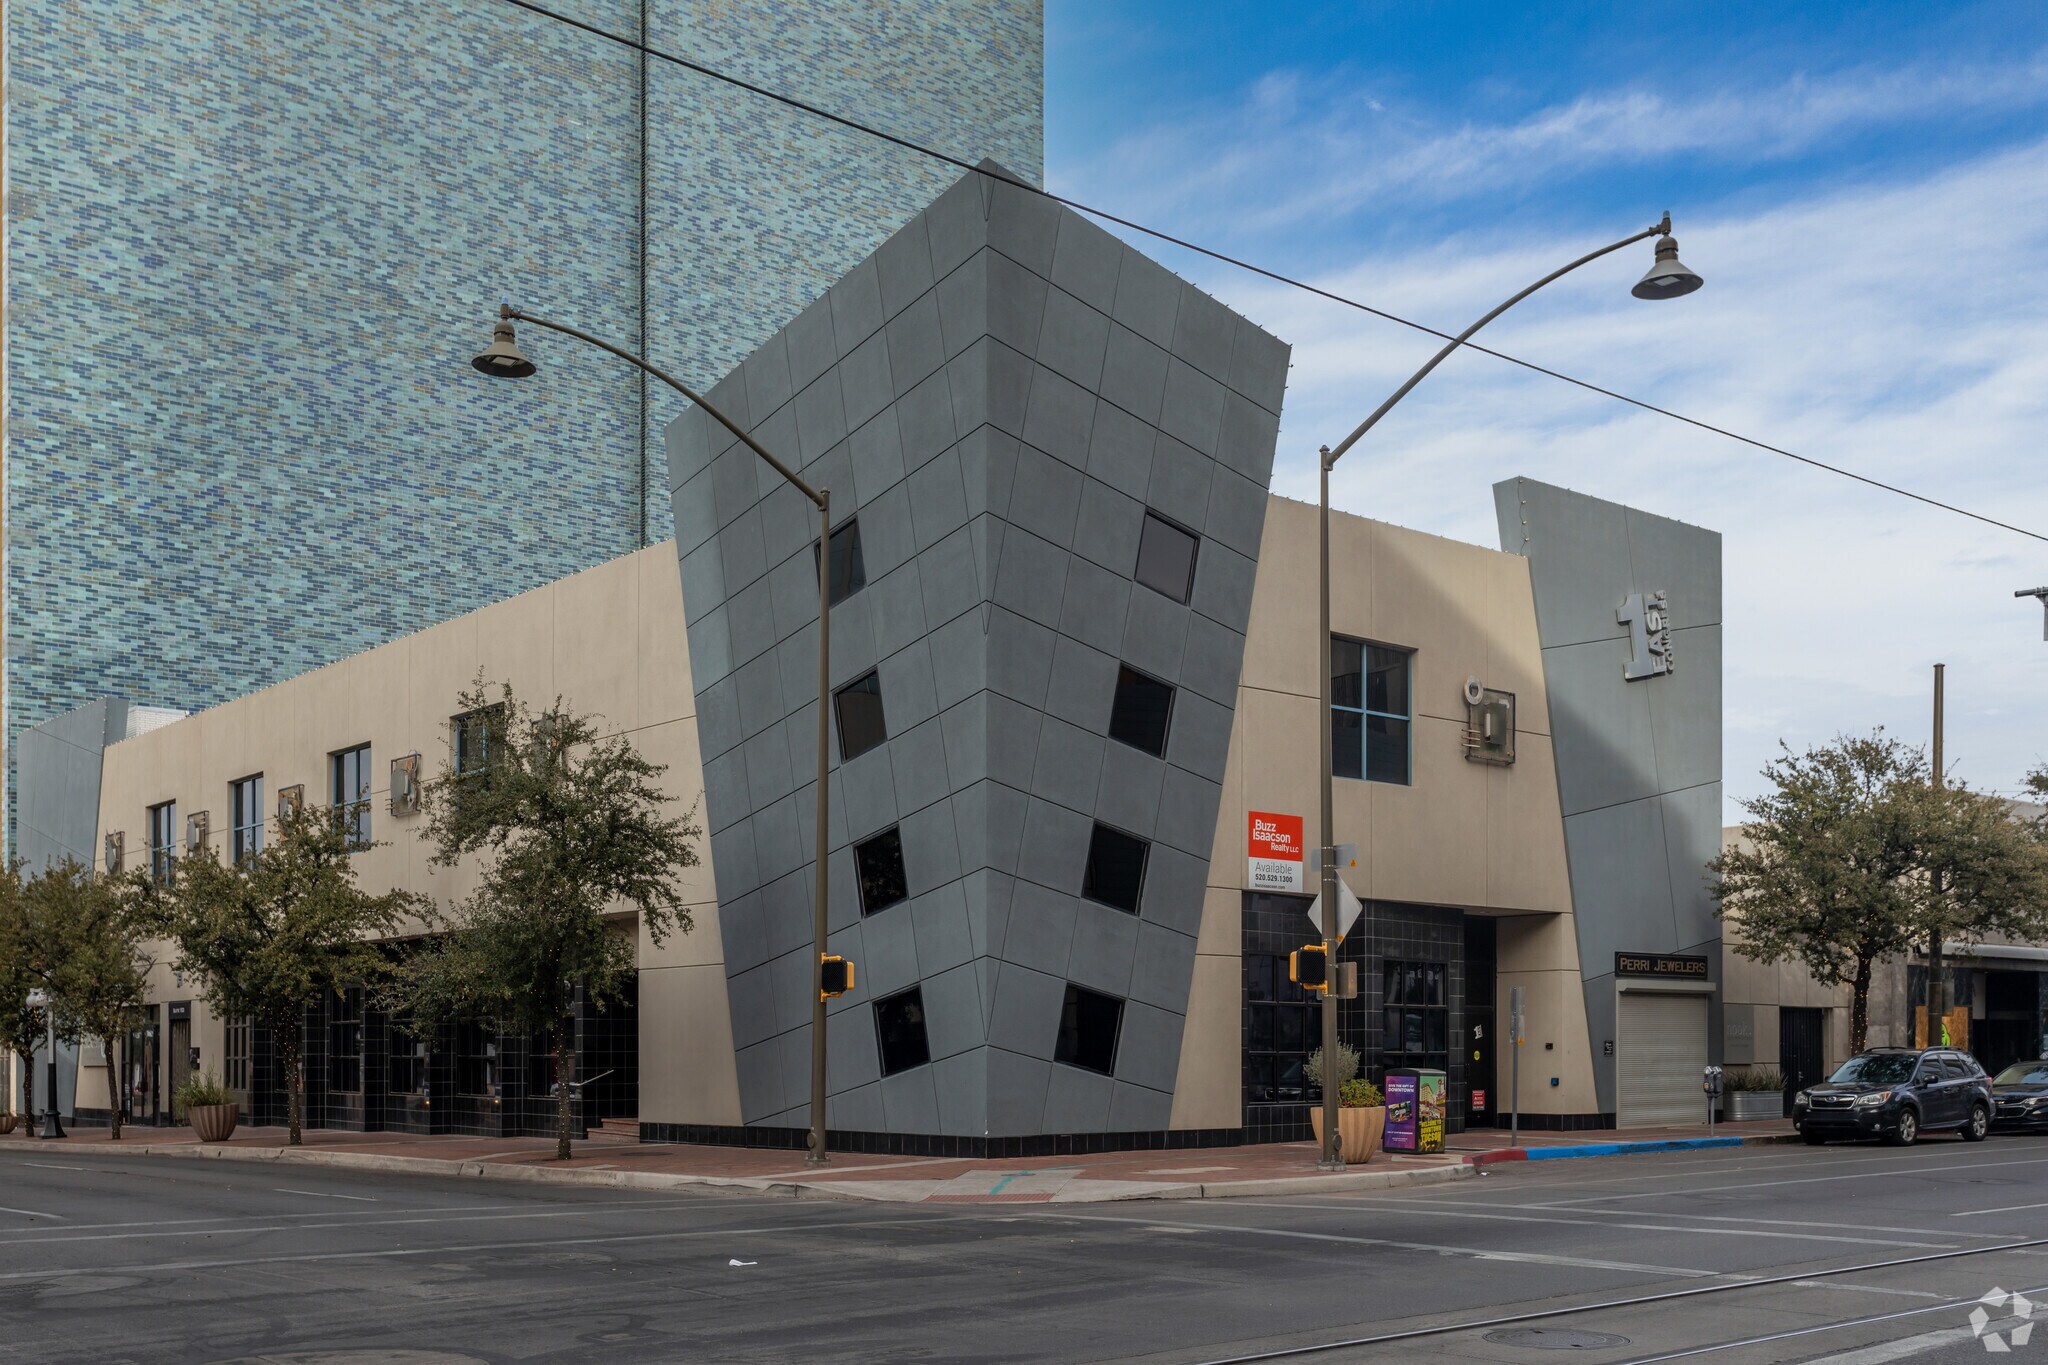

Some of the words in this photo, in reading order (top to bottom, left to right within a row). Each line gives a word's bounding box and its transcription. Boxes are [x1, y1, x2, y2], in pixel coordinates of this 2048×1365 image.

[1618, 593, 1653, 680] 1
[1645, 593, 1666, 674] EAST
[1256, 819, 1276, 832] Buzz
[1253, 829, 1290, 843] Isaacson
[1271, 842, 1289, 853] Realty
[1256, 862, 1292, 874] Available
[1256, 874, 1292, 883] 520.529.1300
[1620, 958, 1650, 971] PERRI
[1654, 959, 1706, 973] JEWELERS
